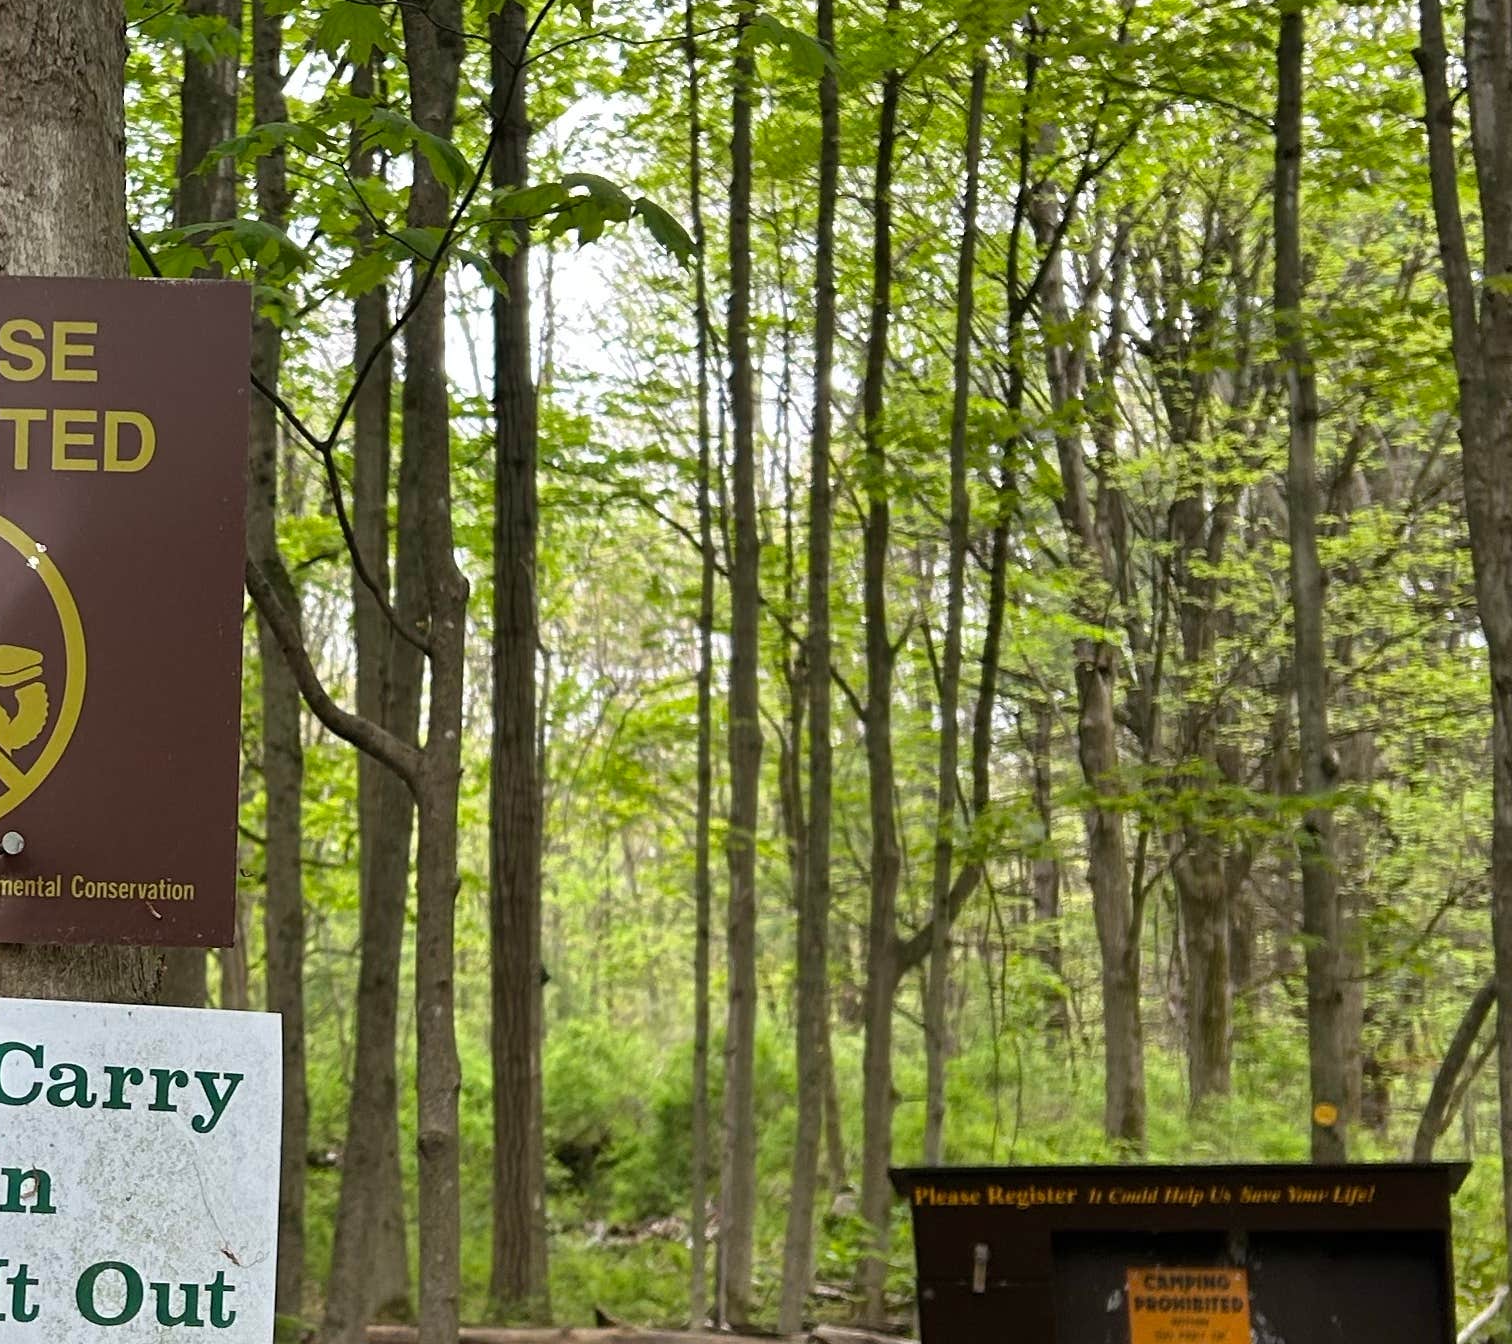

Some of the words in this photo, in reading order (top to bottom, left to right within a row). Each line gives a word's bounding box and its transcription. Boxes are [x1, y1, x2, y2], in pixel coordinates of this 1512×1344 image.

[71, 874, 195, 901] Conservation
[914, 1185, 982, 1206] Please
[988, 1184, 1078, 1210] Register
[1108, 1186, 1159, 1205] Could
[1163, 1185, 1205, 1208] Help
[1209, 1187, 1232, 1204] Us
[1240, 1185, 1282, 1205] Save
[1287, 1185, 1330, 1204] Your
[1333, 1184, 1376, 1207] Life!
[74, 1259, 237, 1330] Out
[1143, 1273, 1231, 1291] CAMPING
[1133, 1295, 1245, 1314] PROHIBITED
